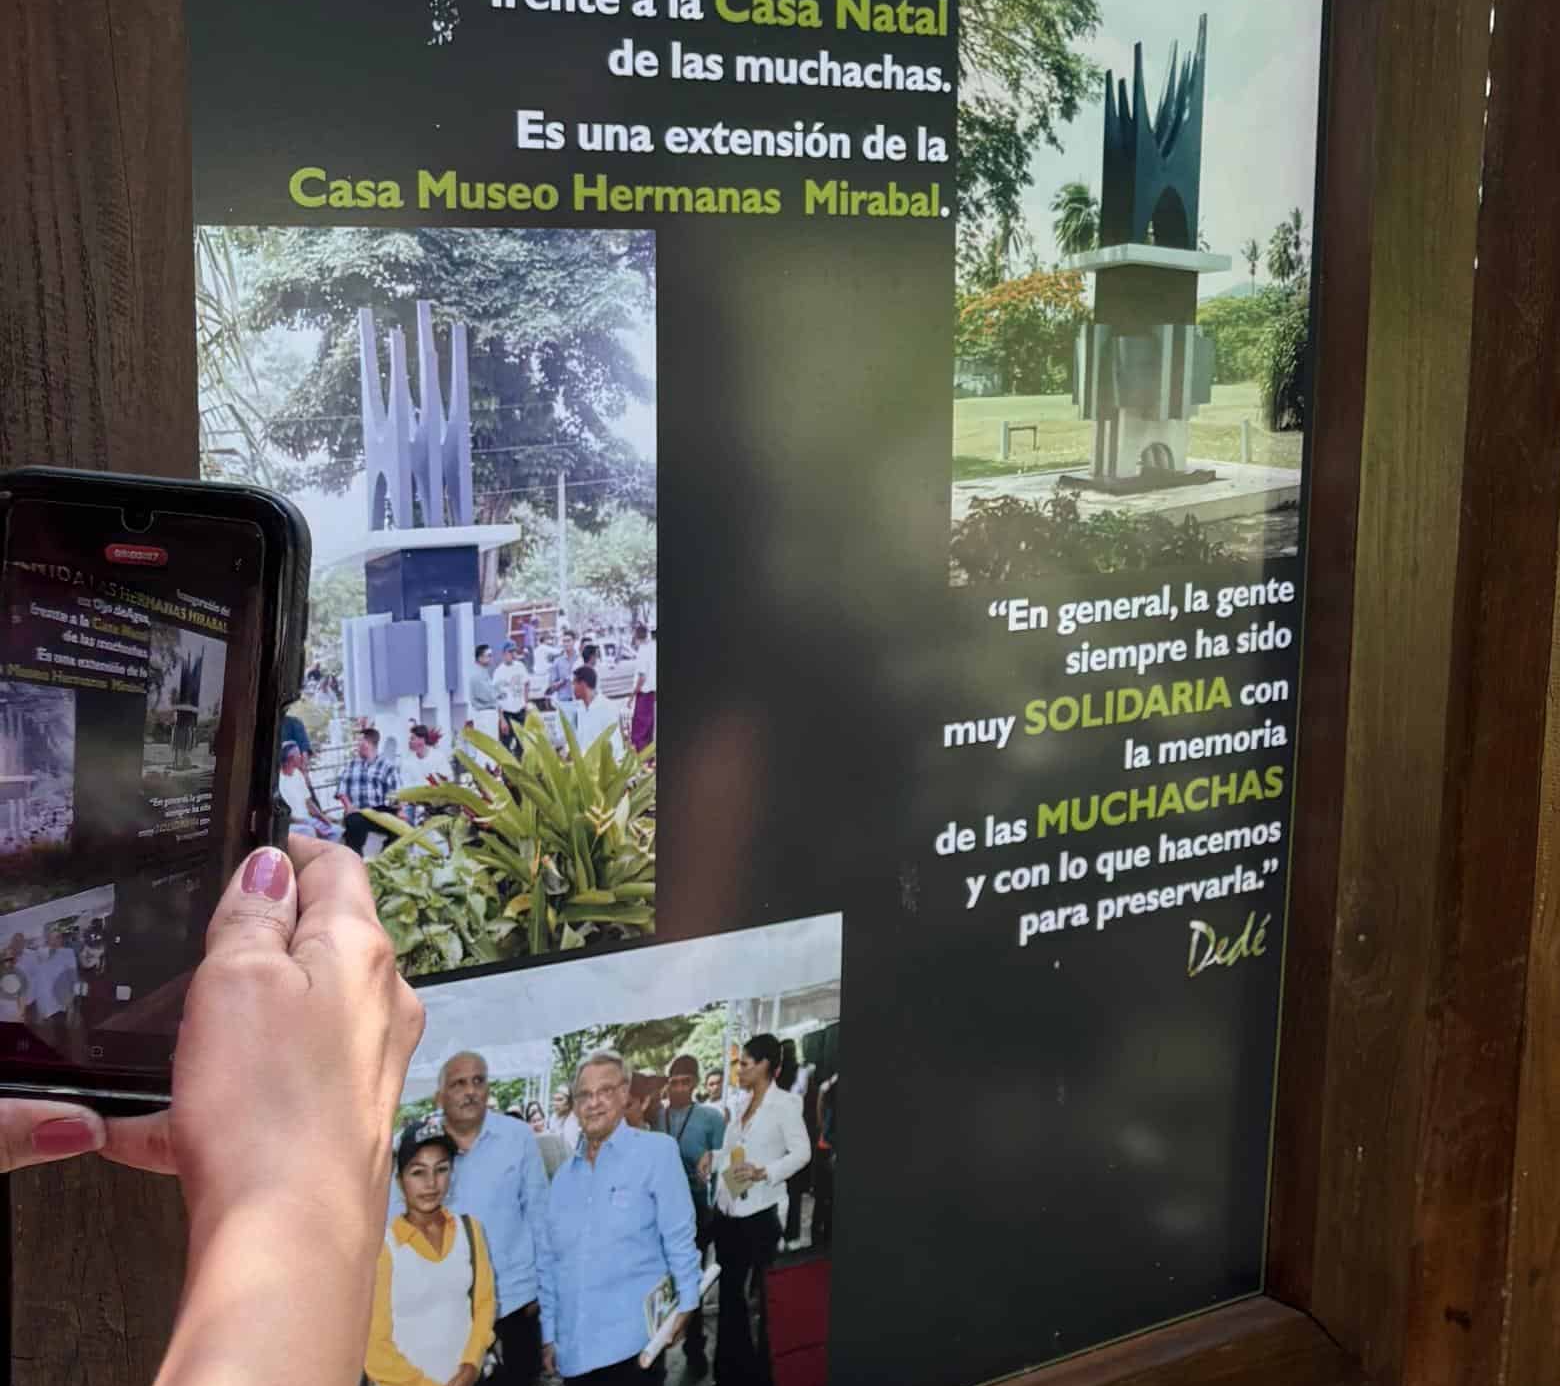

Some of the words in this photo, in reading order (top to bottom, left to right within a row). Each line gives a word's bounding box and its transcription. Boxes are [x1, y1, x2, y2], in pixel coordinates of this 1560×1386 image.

[607, 38, 659, 77] de
[671, 41, 724, 81] las
[735, 50, 952, 93] muchachas.
[517, 109, 566, 150] Es
[577, 123, 655, 153] una
[664, 120, 851, 159] extensión
[862, 124, 907, 161] de
[917, 126, 949, 162] la
[289, 167, 405, 209] Casa
[417, 169, 559, 210] Museo
[573, 173, 782, 214] Hermanas
[805, 179, 951, 218] Mirabal.
[1056, 584, 1179, 635] general,
[1184, 582, 1210, 613] la
[1215, 578, 1295, 618] gente
[1065, 639, 1187, 675] siempre
[1195, 628, 1230, 659] ha
[1236, 620, 1292, 654] sido
[943, 715, 1016, 749] muy
[1023, 676, 1233, 736] SOLIDARIA
[1239, 680, 1289, 706] con
[1124, 738, 1151, 770] la
[1158, 718, 1288, 764] memoria
[935, 821, 976, 855] de
[985, 815, 1027, 847] las
[1037, 766, 1283, 838] MUCHACHAS
[966, 874, 986, 909] y
[993, 863, 1050, 894] con
[1059, 851, 1088, 882] lo
[1095, 845, 1151, 882] que
[1158, 821, 1282, 864] hacemos
[1019, 903, 1090, 947] para
